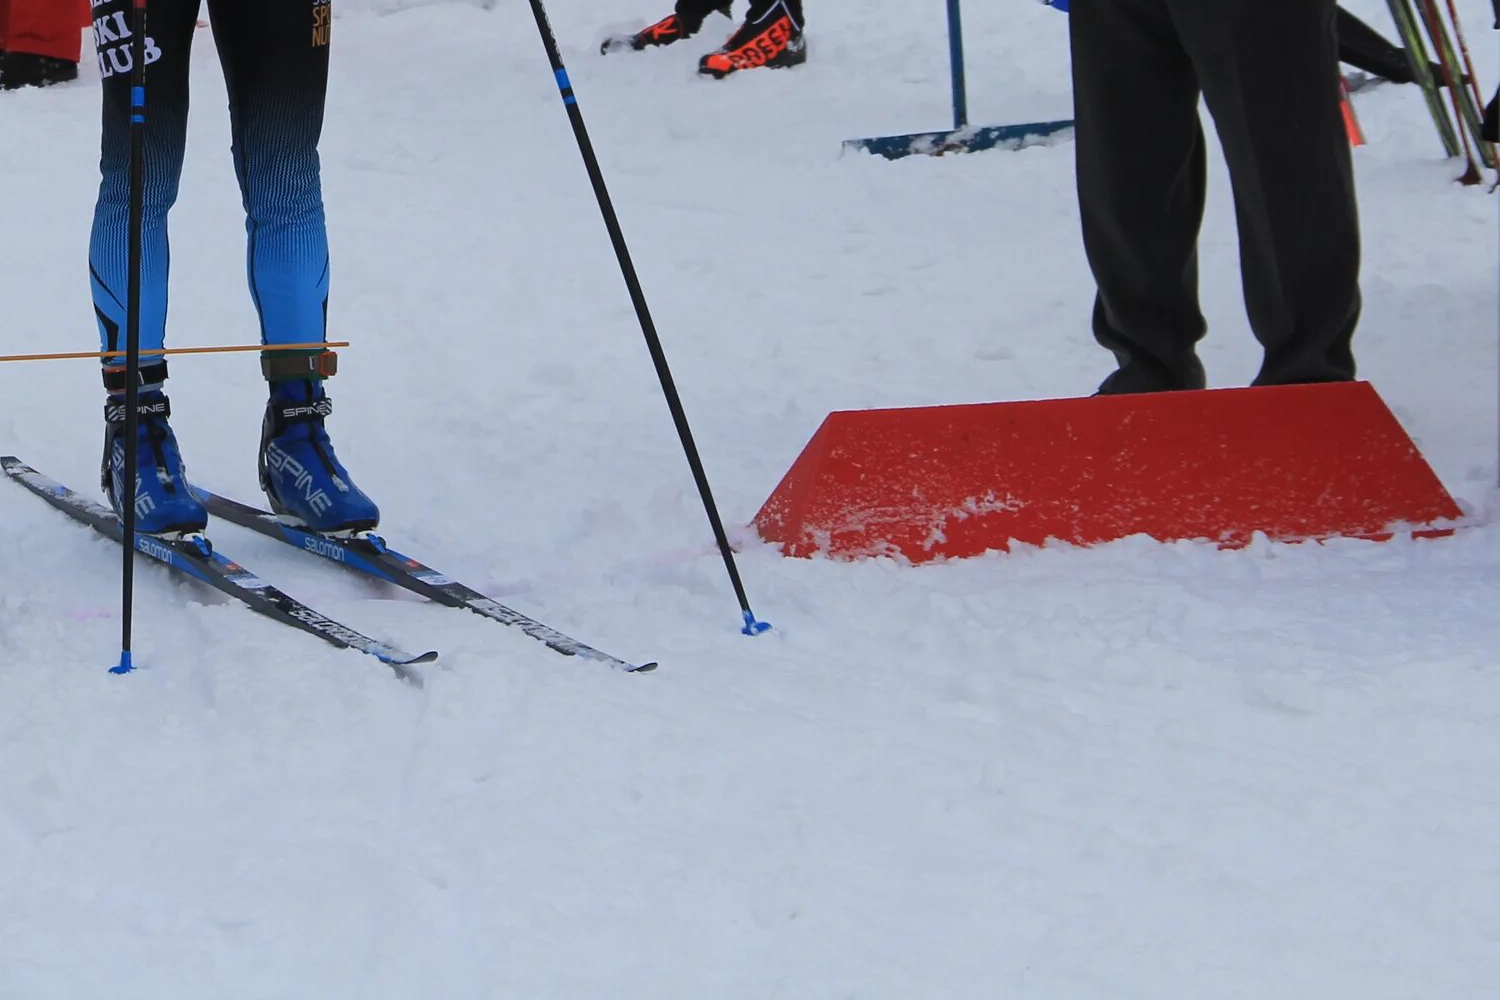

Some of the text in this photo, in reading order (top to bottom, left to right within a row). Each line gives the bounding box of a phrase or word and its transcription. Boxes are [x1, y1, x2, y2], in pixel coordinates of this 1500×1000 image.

[99, 37, 162, 78] LUB
[117, 403, 165, 416] SINE
[283, 404, 328, 417] SPINE
[268, 441, 332, 518] SPINE
